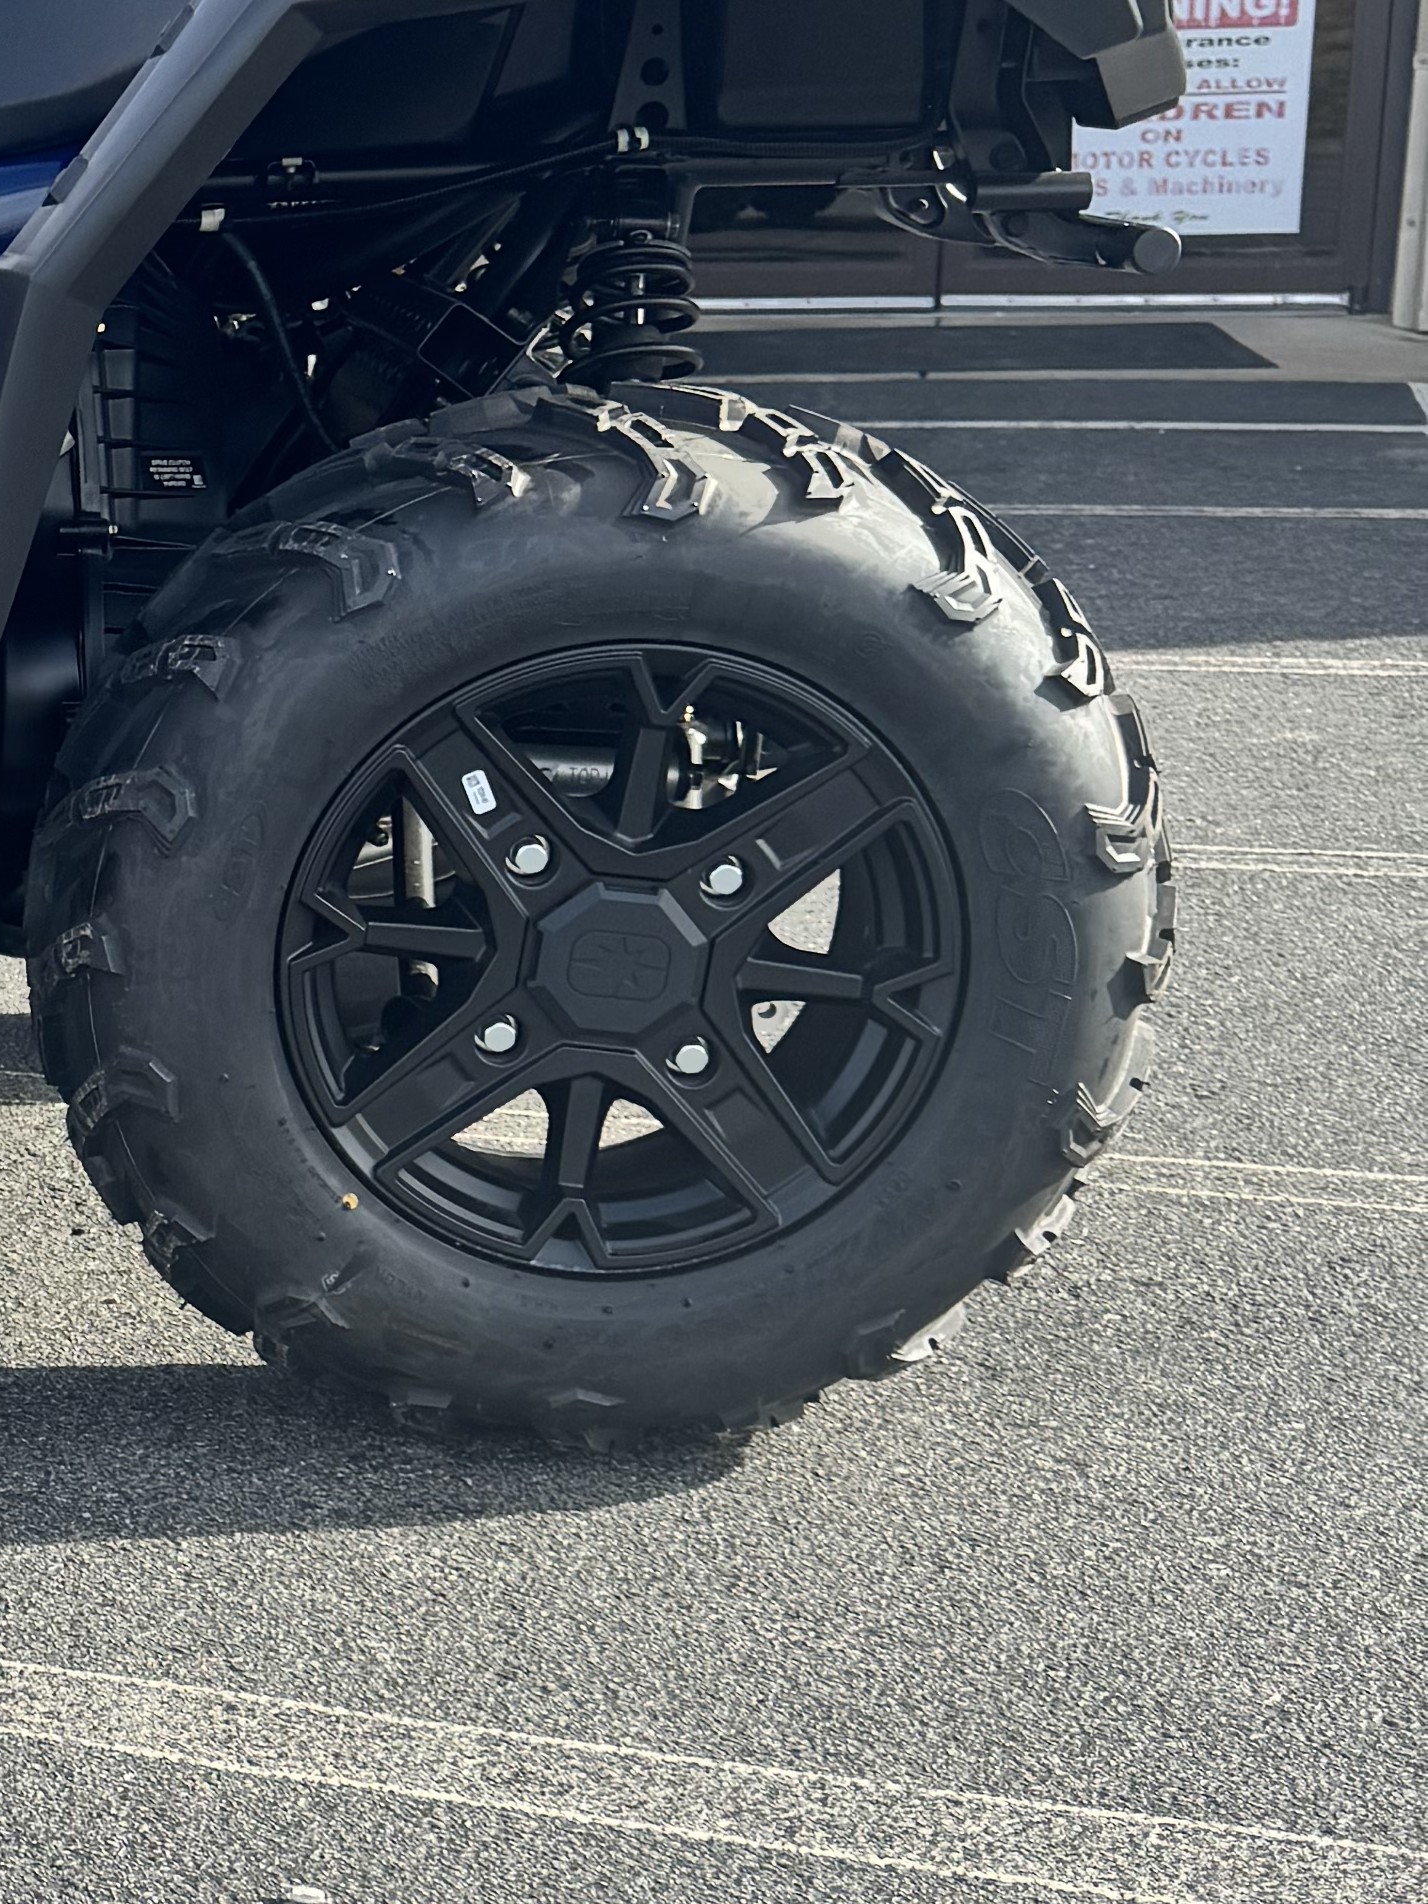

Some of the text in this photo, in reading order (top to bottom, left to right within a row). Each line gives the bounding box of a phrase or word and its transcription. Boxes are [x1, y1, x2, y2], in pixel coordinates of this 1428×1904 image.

[1186, 35, 1271, 48] rance
[1196, 77, 1287, 90] ALLOW
[1158, 100, 1286, 121] DREN
[1140, 128, 1183, 144] ON
[1165, 147, 1271, 169] CYCLES
[1147, 175, 1285, 197] Machinery
